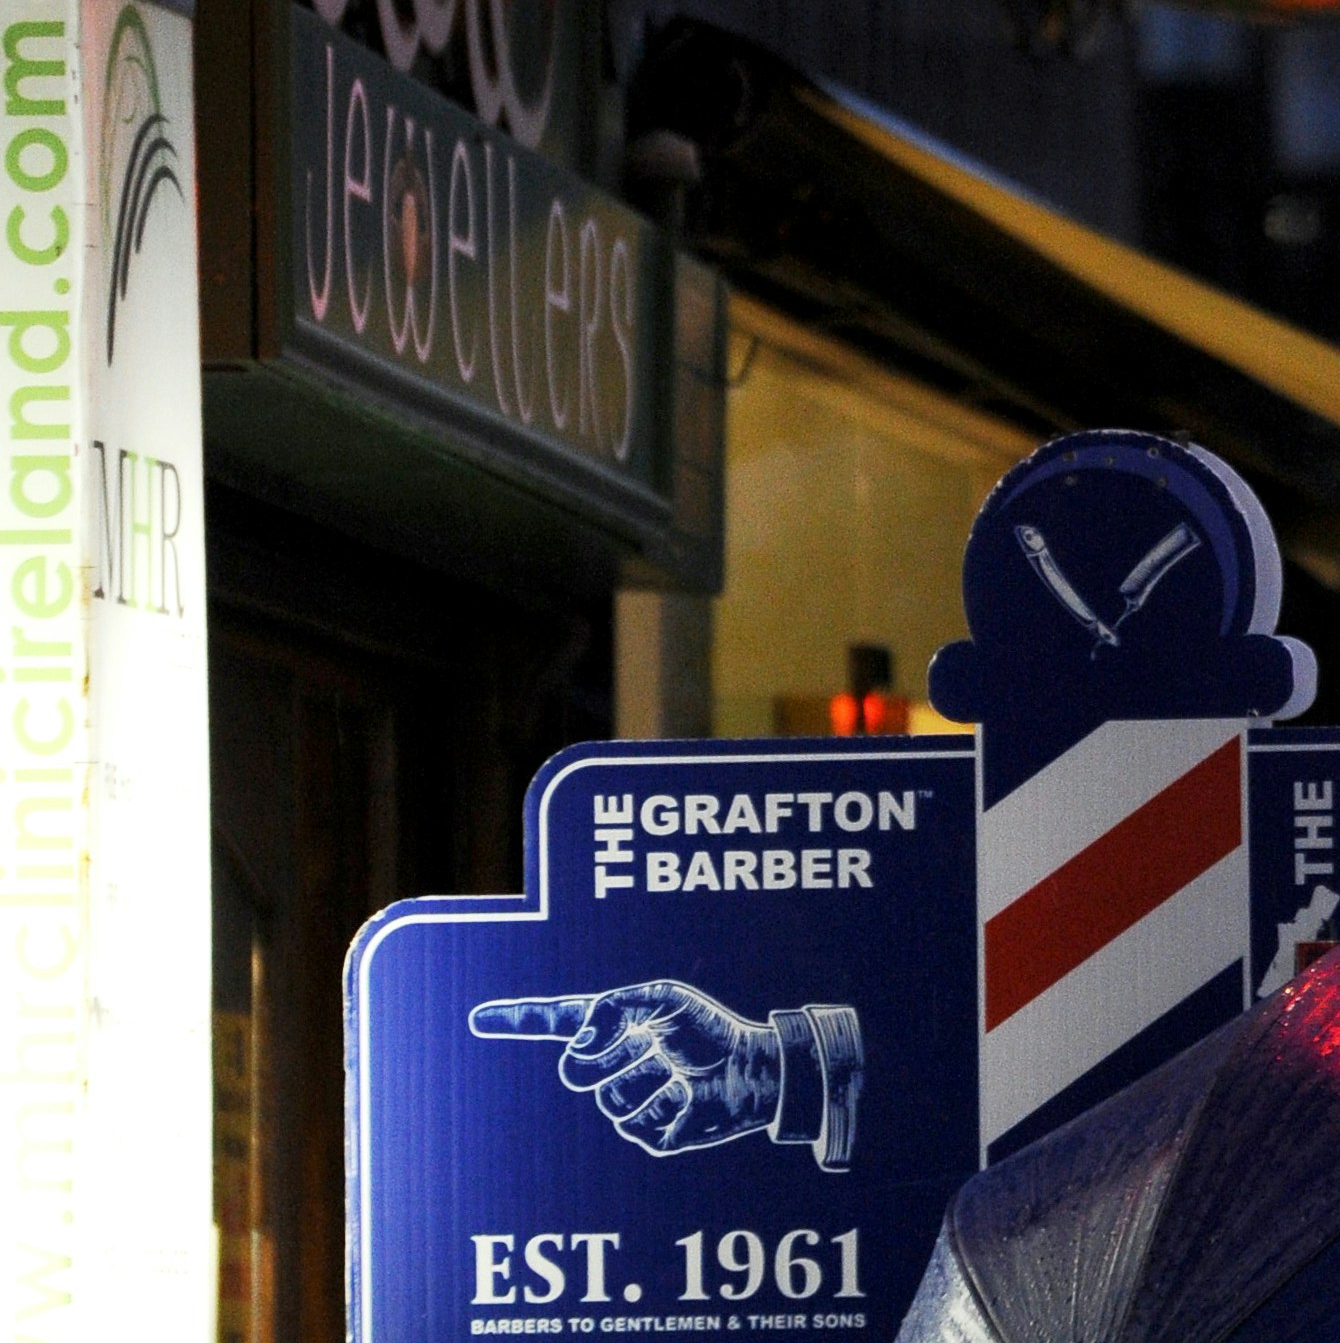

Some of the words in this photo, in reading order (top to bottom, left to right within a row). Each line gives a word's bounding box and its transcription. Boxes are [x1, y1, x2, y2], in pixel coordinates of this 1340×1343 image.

[92, 440, 185, 619] MHR
[594, 793, 634, 899] THE
[639, 790, 917, 836] GRAFTON
[1294, 779, 1334, 885] THE
[645, 848, 875, 893] BARBER
[470, 1232, 643, 1305] EST.
[674, 1228, 867, 1302] 1961
[470, 1317, 563, 1335] BARBERS
[567, 1316, 596, 1334] TO
[599, 1314, 722, 1333] GENTLEMEN
[726, 1315, 741, 1331] &
[747, 1313, 808, 1331] THEIR
[811, 1312, 867, 1330] SONS
